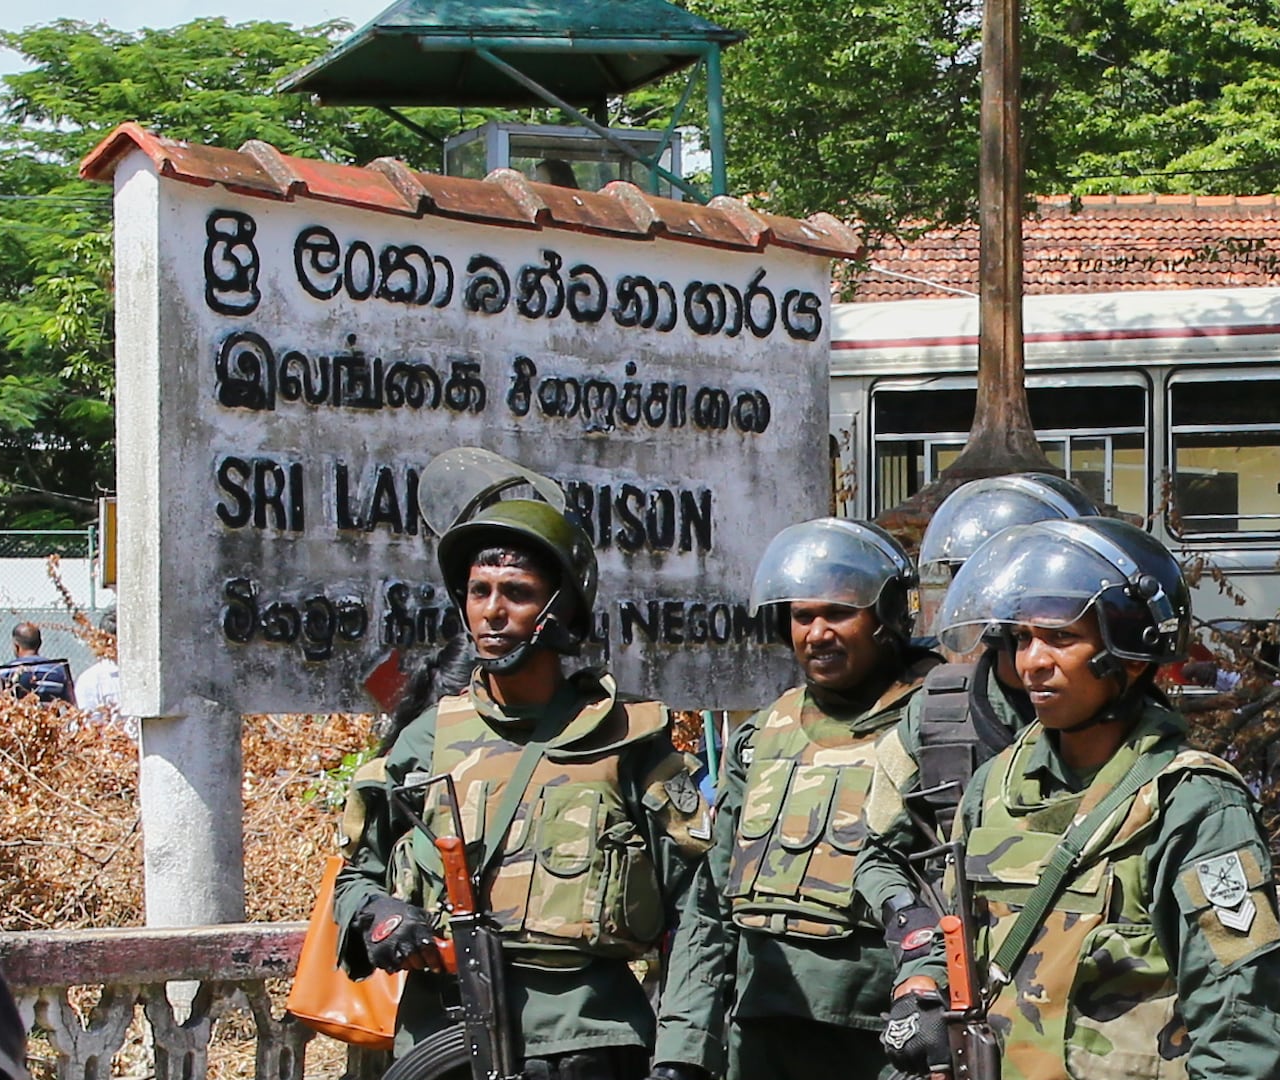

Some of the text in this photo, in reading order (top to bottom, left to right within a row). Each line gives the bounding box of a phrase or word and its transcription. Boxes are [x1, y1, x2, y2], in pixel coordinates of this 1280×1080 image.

[293, 225, 455, 308] ලංකා
[215, 330, 487, 414] இலங்கை
[216, 455, 305, 532] SRI
[535, 476, 714, 553] RISON
